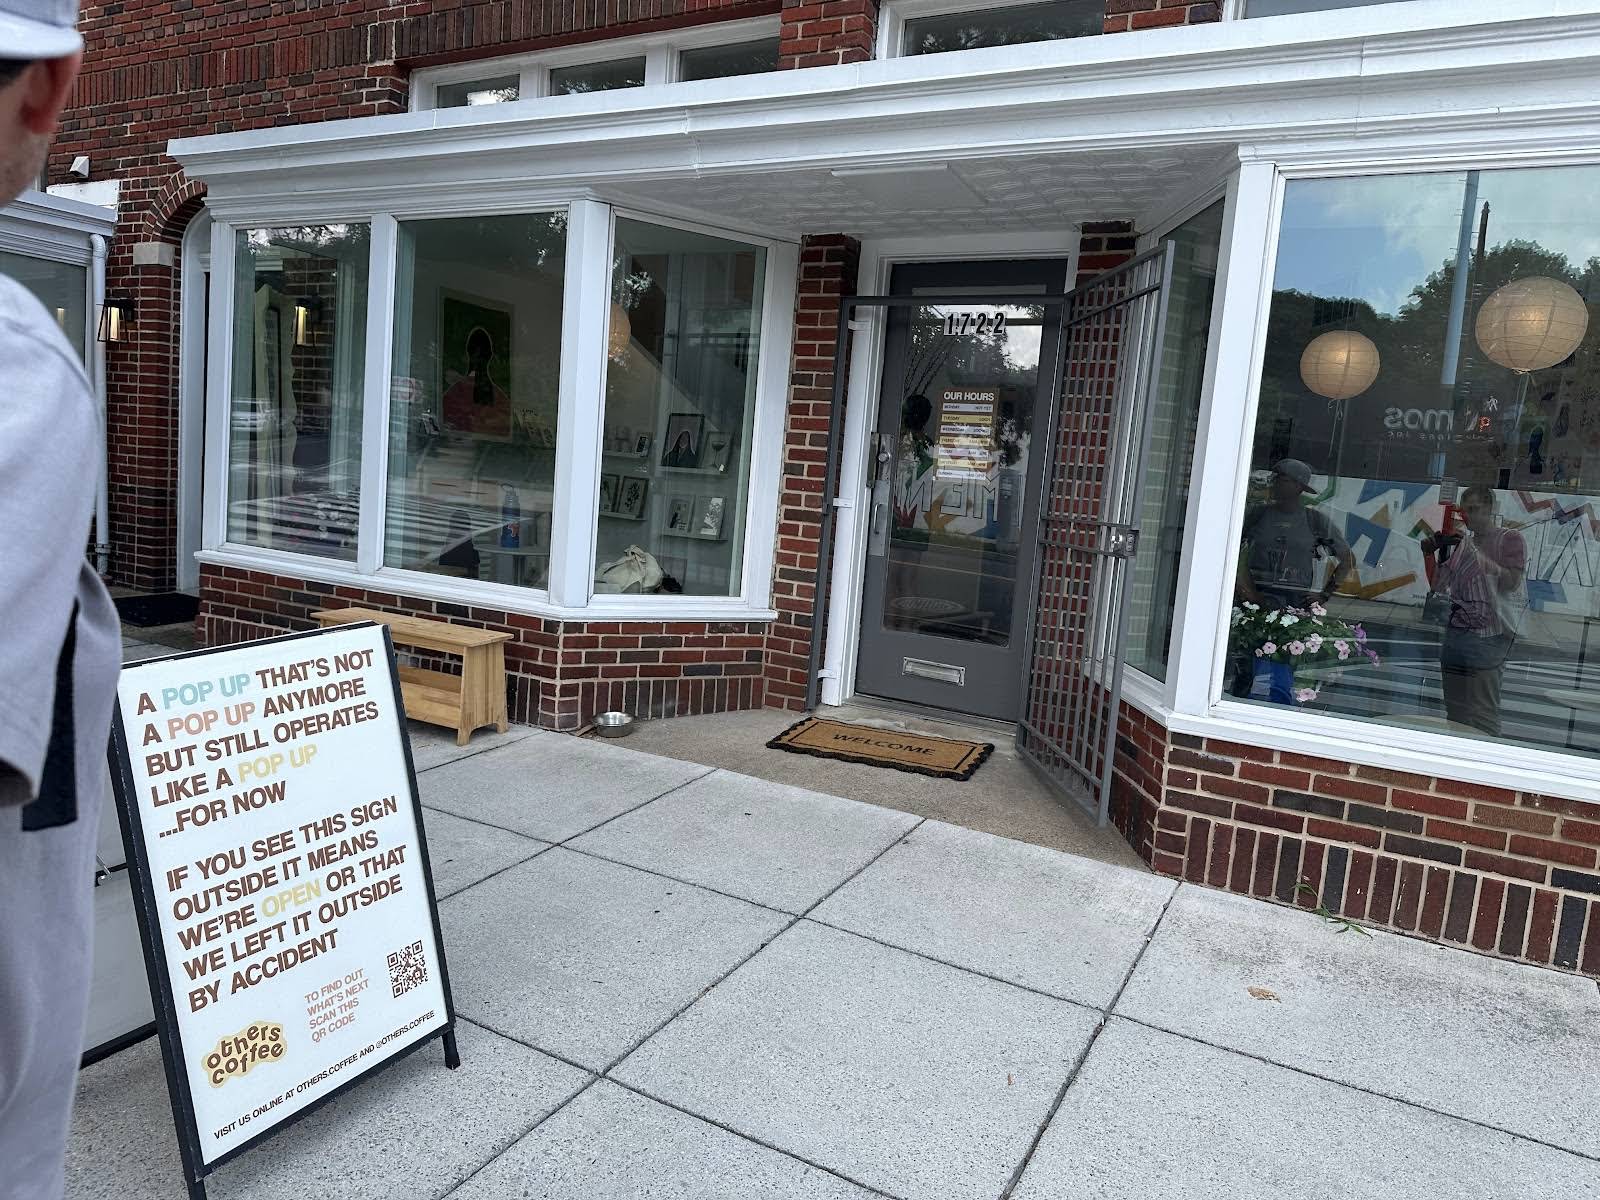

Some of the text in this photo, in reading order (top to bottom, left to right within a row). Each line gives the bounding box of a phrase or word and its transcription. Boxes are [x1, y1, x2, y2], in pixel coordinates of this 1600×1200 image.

[946, 312, 1006, 335] 1722
[944, 391, 995, 402] OUR HOURS
[137, 649, 374, 715] A POP UP THAT'S NOT
[142, 677, 367, 746] A POP UP ANYMORE
[145, 701, 379, 777] BUT STILL OPERATES
[834, 733, 937, 756] WELCOME
[150, 743, 318, 808] LIKE A POP UP
[159, 781, 286, 838] ...FOR NOW
[166, 795, 398, 892] IF YOU SEE THIS SIGN
[173, 829, 379, 921] OUTSIDE IT MEANS
[177, 844, 408, 951] WE'RE OPEN OR THAT
[182, 874, 403, 981] WE LEFT IT OUTSIDE
[188, 928, 339, 1013] BY ACCIDENT
[305, 968, 364, 1004] TO FIND OUT
[307, 979, 370, 1017] WHAT'S NEXT
[309, 997, 360, 1030] SCAN THIS
[311, 1012, 356, 1042] QR CODE
[207, 1024, 281, 1069] others
[212, 1042, 283, 1085] coffee
[214, 1010, 435, 1140] VISIT US ONLINE AT OTHERS.COFFEE AND @OTHERS.COFFEE
